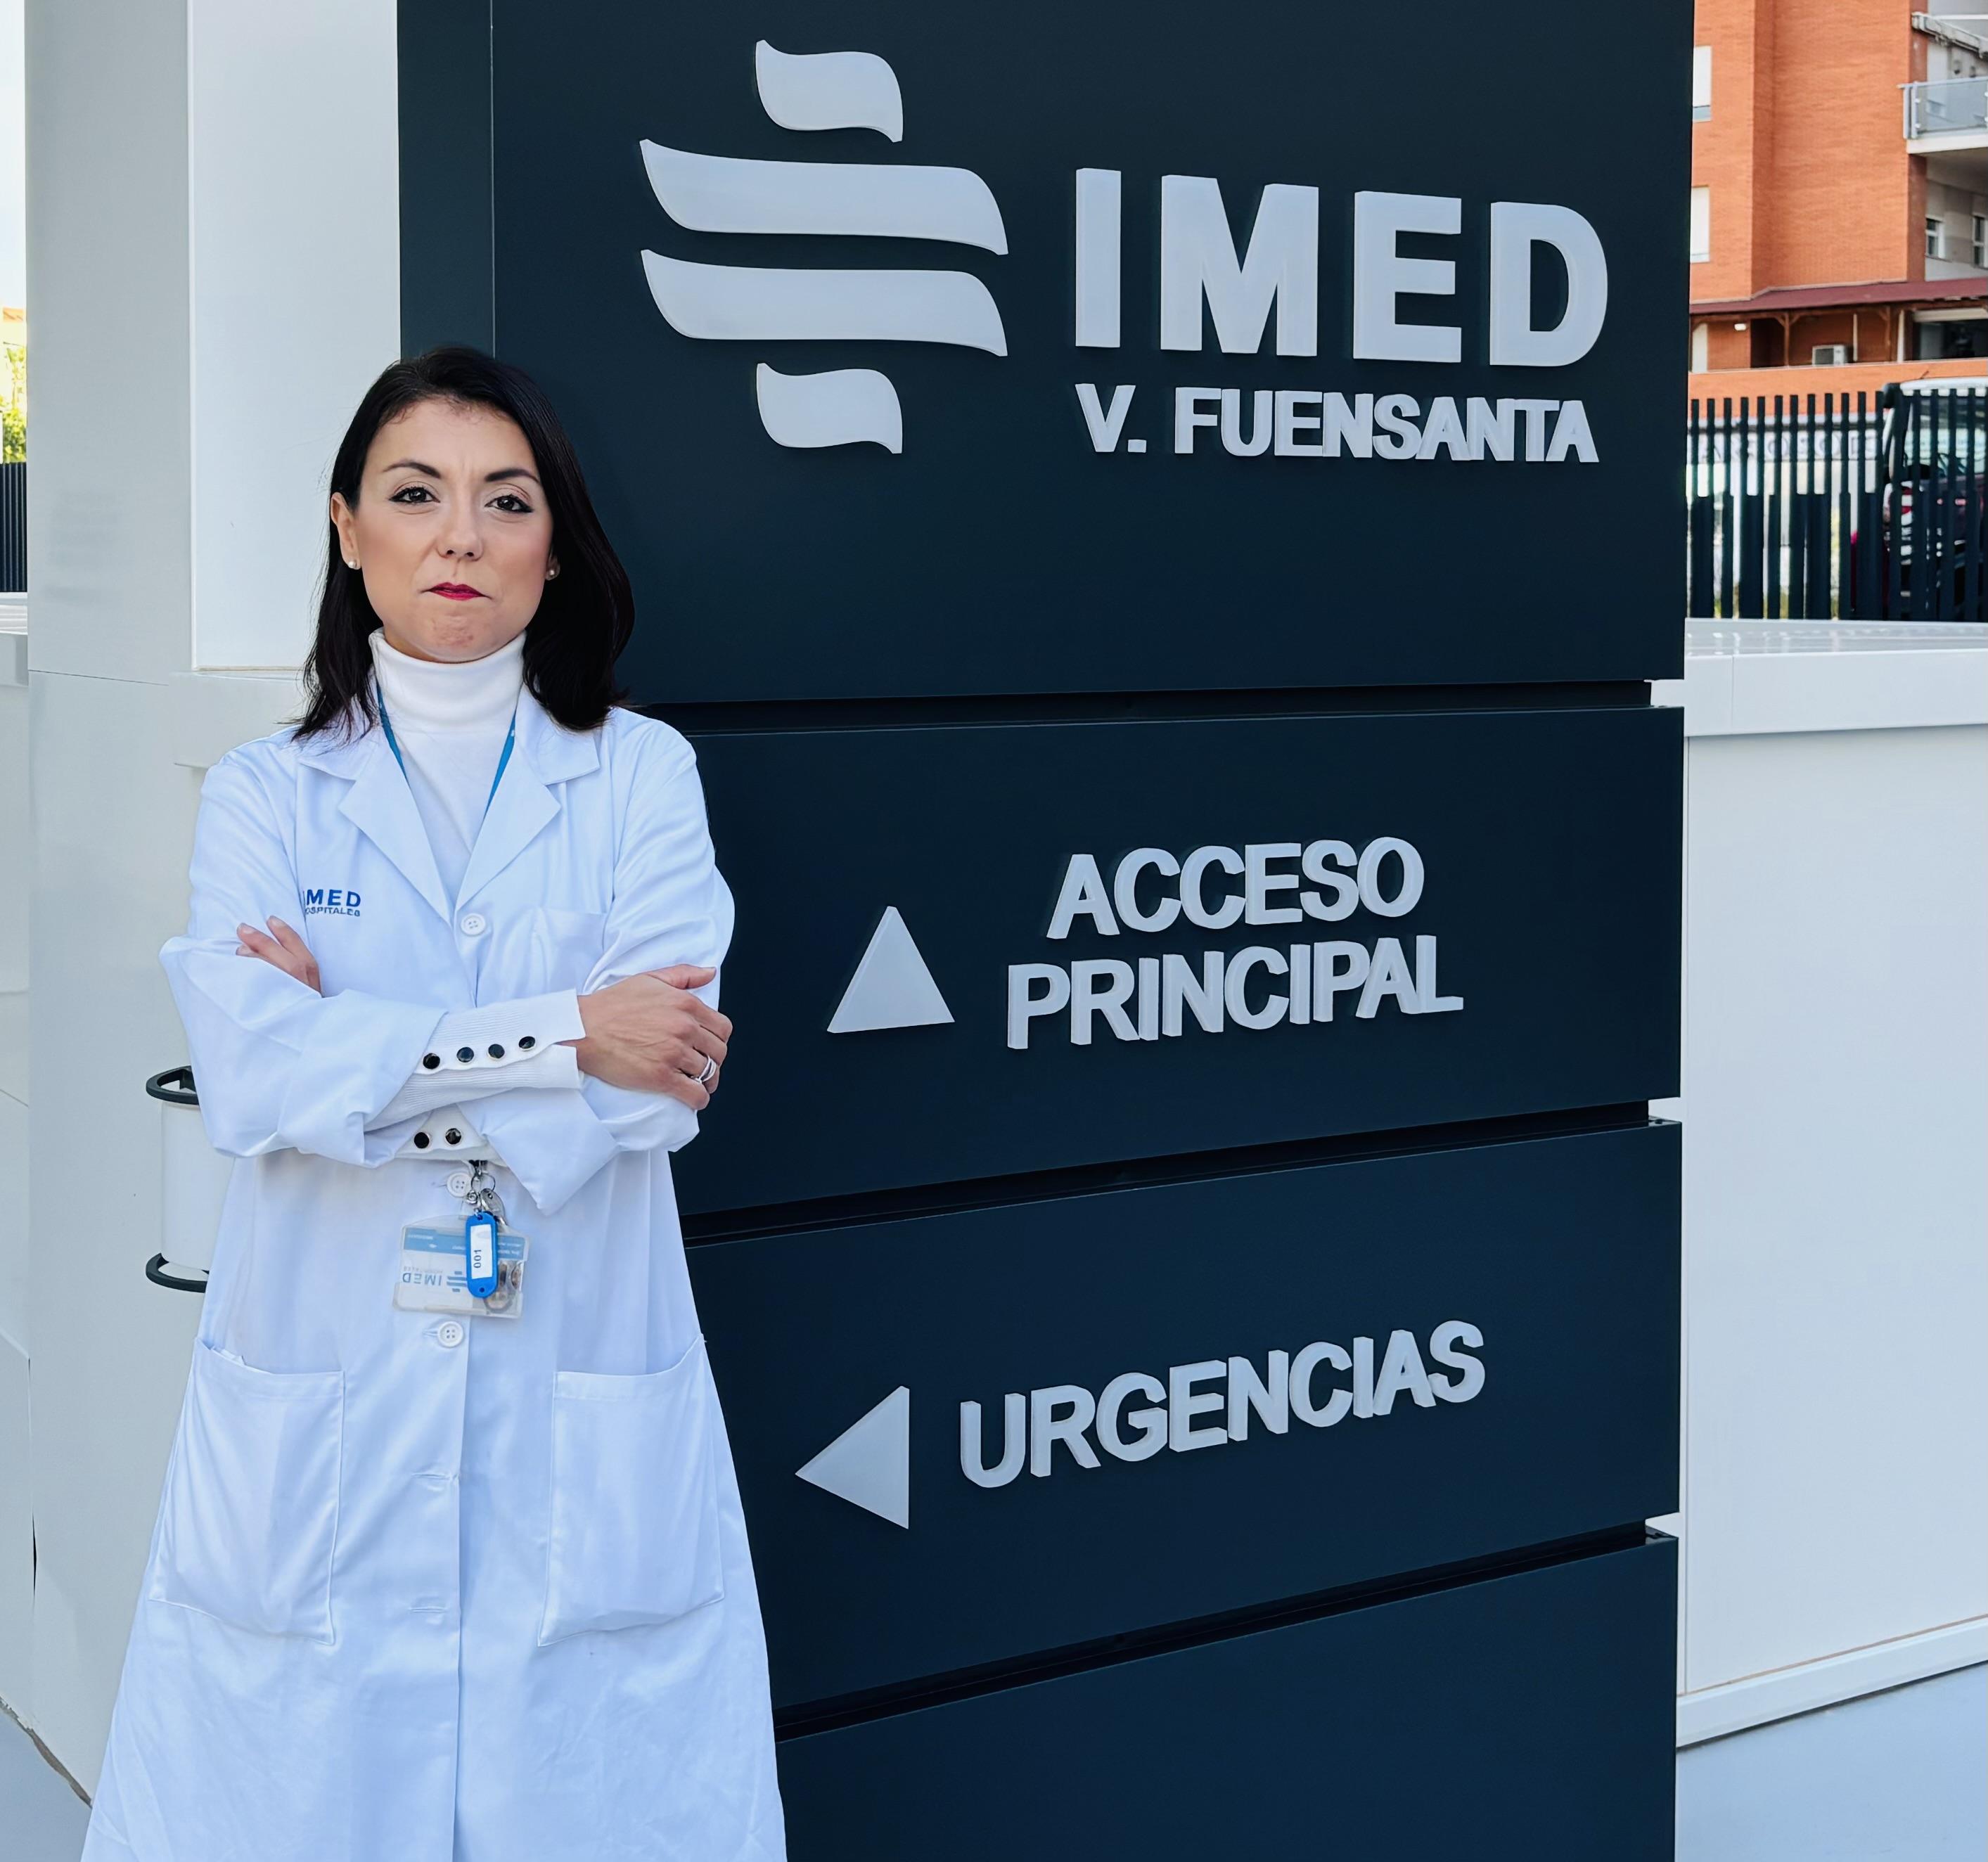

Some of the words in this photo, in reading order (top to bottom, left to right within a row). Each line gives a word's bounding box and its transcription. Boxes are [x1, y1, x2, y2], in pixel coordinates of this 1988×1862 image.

[1075, 167, 1608, 367] IMED
[1075, 383, 1147, 454] V.
[1174, 387, 1600, 463] FUENSANTA
[303, 889, 361, 907] MED
[1046, 836, 1425, 939] ACCESO
[1007, 935, 1464, 1050] PRINCIPAL
[402, 1271, 442, 1286] IMED
[473, 1249, 482, 1269] 001
[960, 1320, 1486, 1489] URGENCIAS
